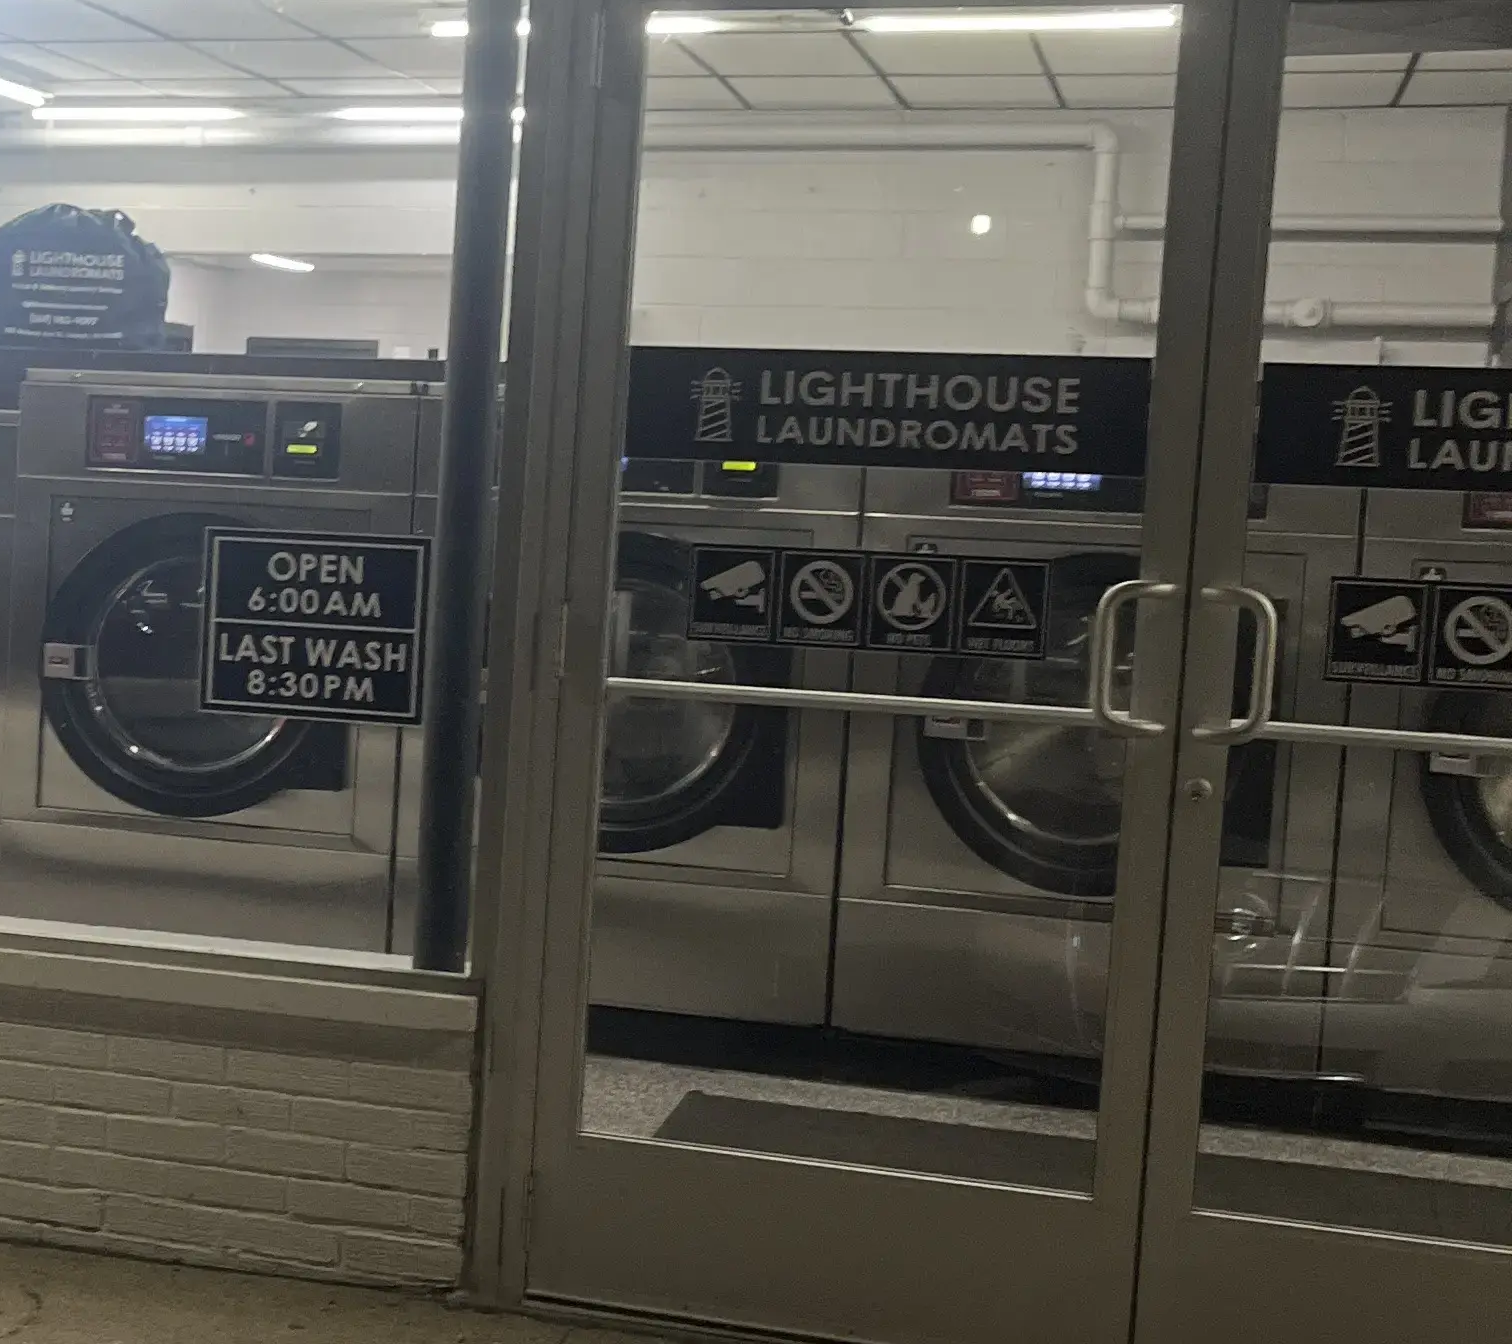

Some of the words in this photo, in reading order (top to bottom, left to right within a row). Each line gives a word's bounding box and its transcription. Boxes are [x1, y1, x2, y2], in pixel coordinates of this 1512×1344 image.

[759, 369, 1081, 414] LIGHTHOUSE
[1413, 389, 1512, 429] LIG
[756, 415, 1079, 455] LAUNDROMATS
[267, 551, 365, 585] OPEN
[219, 632, 296, 665] LAST
[304, 637, 407, 673] WASH
